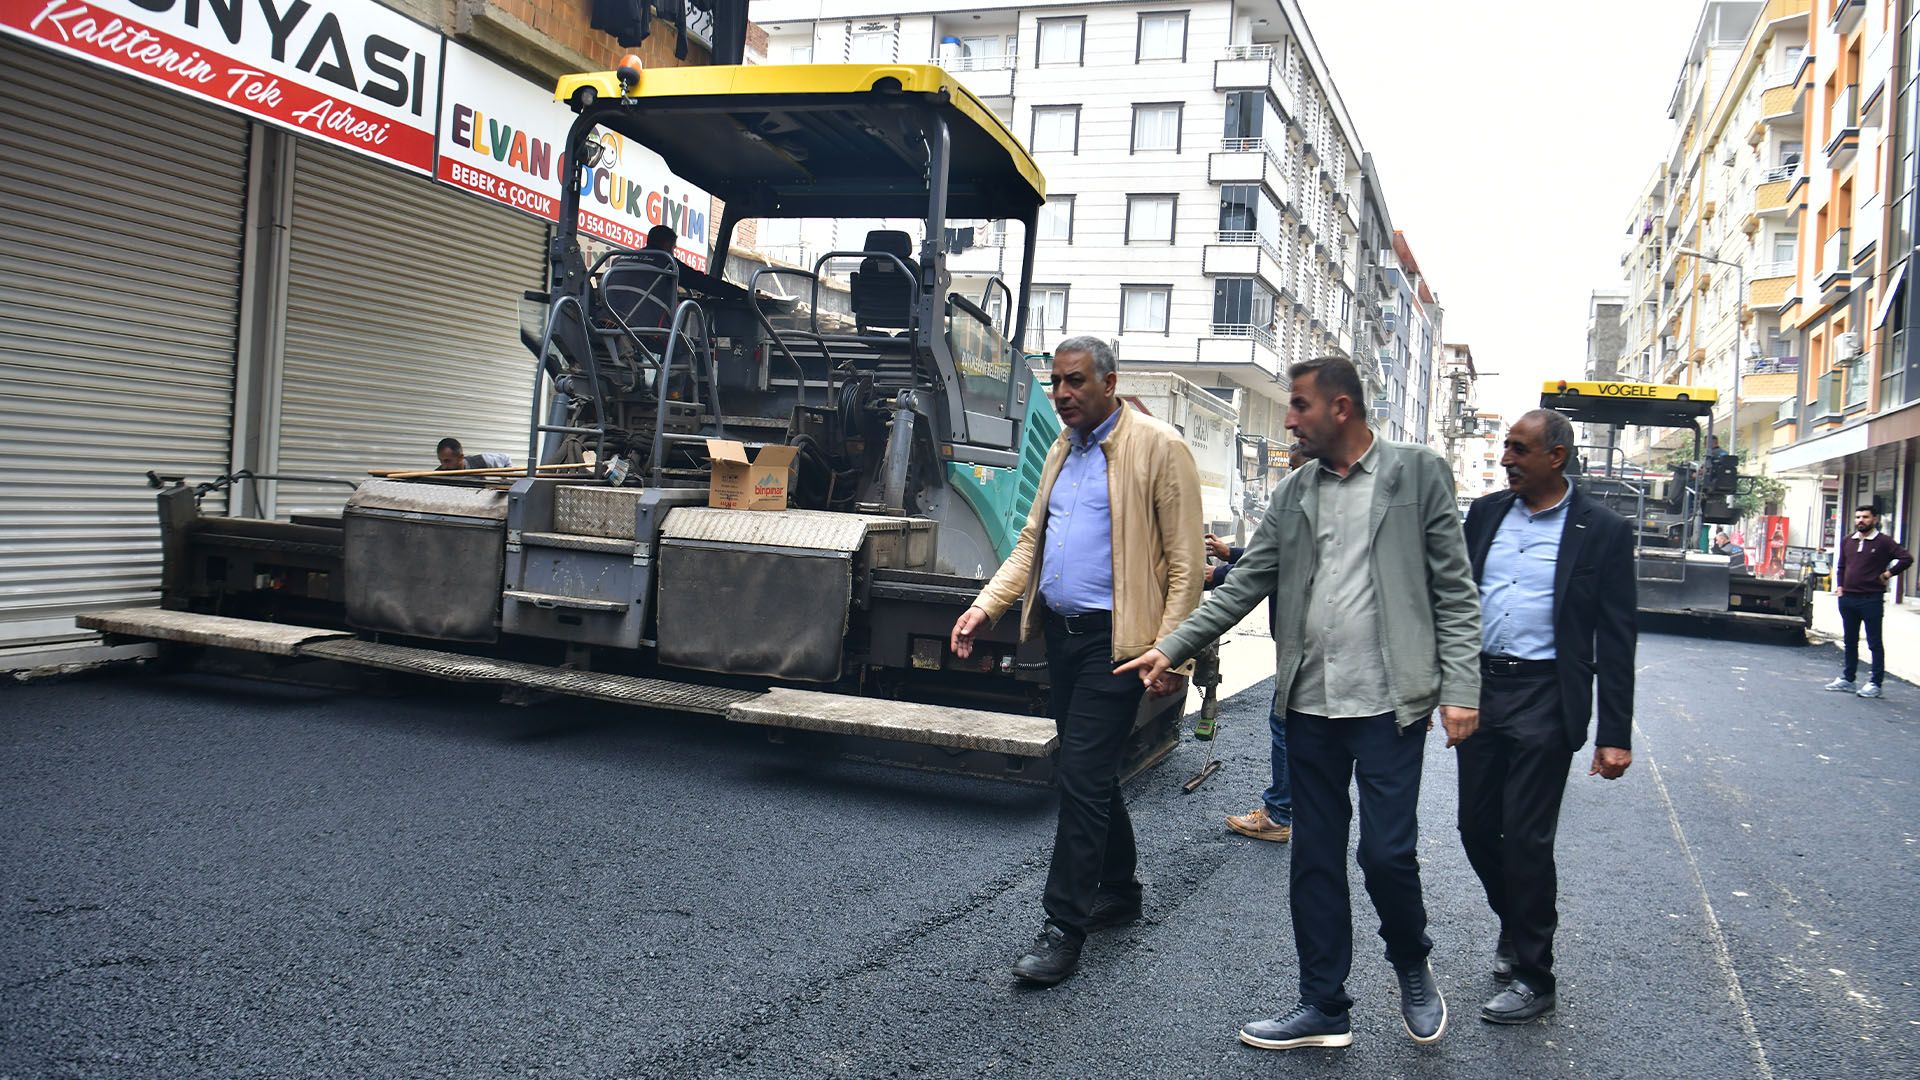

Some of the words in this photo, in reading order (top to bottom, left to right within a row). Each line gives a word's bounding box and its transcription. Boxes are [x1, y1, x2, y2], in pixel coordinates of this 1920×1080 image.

[30, 0, 216, 84] Kalitenin
[227, 68, 283, 108] Tek
[292, 99, 390, 146] Adresi
[451, 163, 496, 192] BEBEK
[497, 181, 508, 197] &
[509, 186, 550, 214] ÇOCUK
[452, 103, 551, 180] ELVAN
[646, 185, 705, 244] GİYİM
[578, 213, 586, 227] 0
[587, 215, 604, 234] 554
[605, 222, 621, 241] 025
[623, 230, 634, 244] 79
[687, 254, 697, 268] 46
[697, 257, 706, 271] 75
